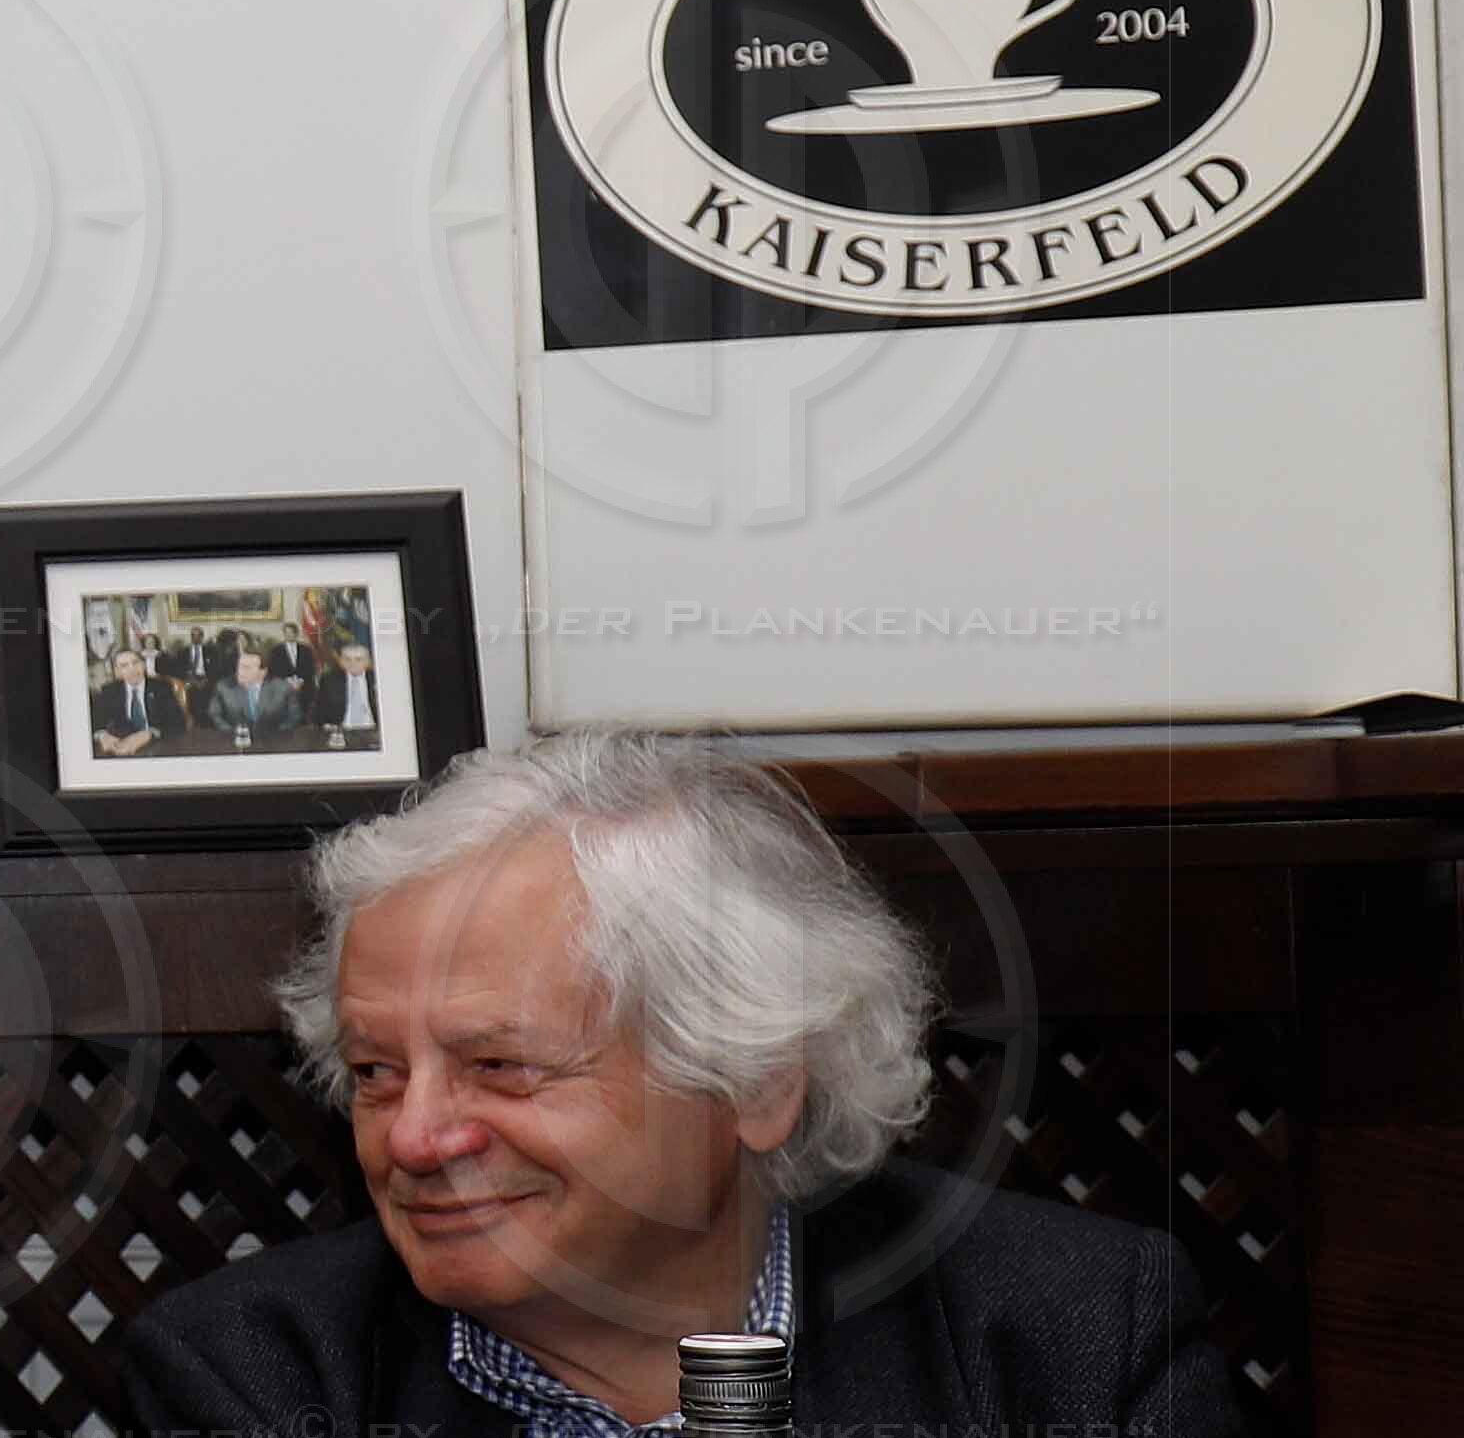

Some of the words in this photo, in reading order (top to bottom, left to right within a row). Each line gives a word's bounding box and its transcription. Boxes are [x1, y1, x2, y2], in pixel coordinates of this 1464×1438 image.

[1096, 5, 1191, 45] 2004
[734, 35, 830, 73] since
[682, 154, 1250, 293] KAISERFELD
